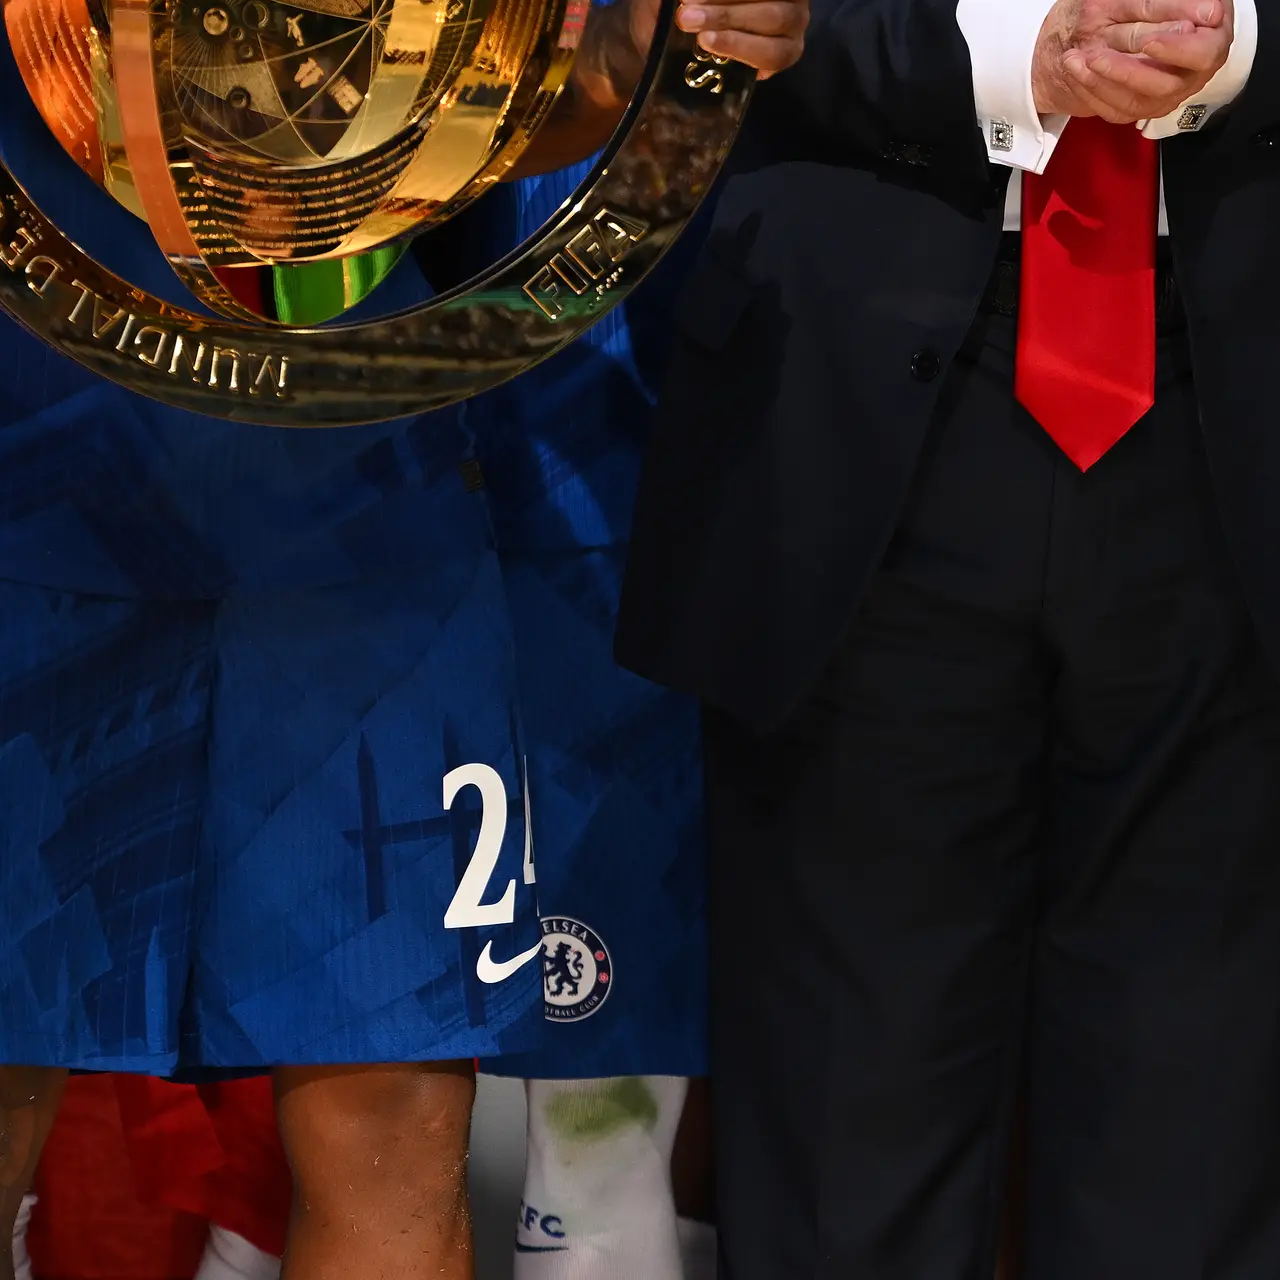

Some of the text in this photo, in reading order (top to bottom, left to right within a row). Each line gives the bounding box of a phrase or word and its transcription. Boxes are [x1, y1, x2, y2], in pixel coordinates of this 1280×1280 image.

[521, 206, 651, 320] FIFA
[67, 277, 290, 399] MUNDIAL
[542, 920, 587, 941] ELSEA
[580, 995, 599, 1013] CLUB
